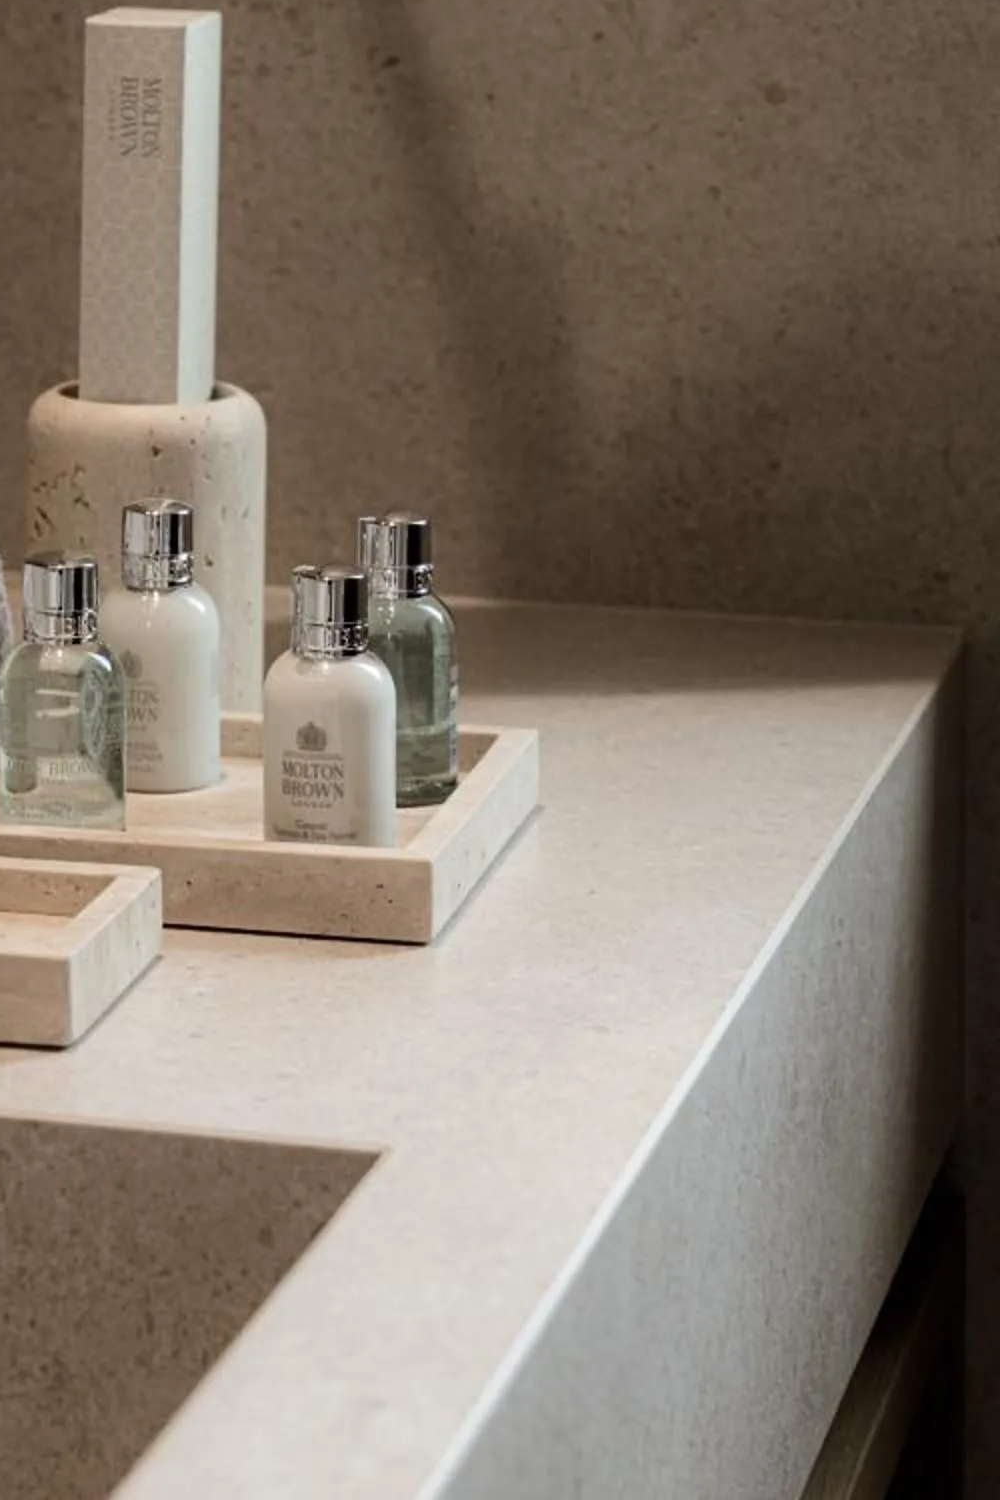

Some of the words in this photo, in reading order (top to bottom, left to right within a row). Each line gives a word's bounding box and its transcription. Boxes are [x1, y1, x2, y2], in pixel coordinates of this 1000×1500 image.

[119, 77, 139, 157] BROWN
[142, 77, 163, 158] MOLTON
[281, 778, 345, 800] BROWN
[282, 759, 345, 779] MOLTON
